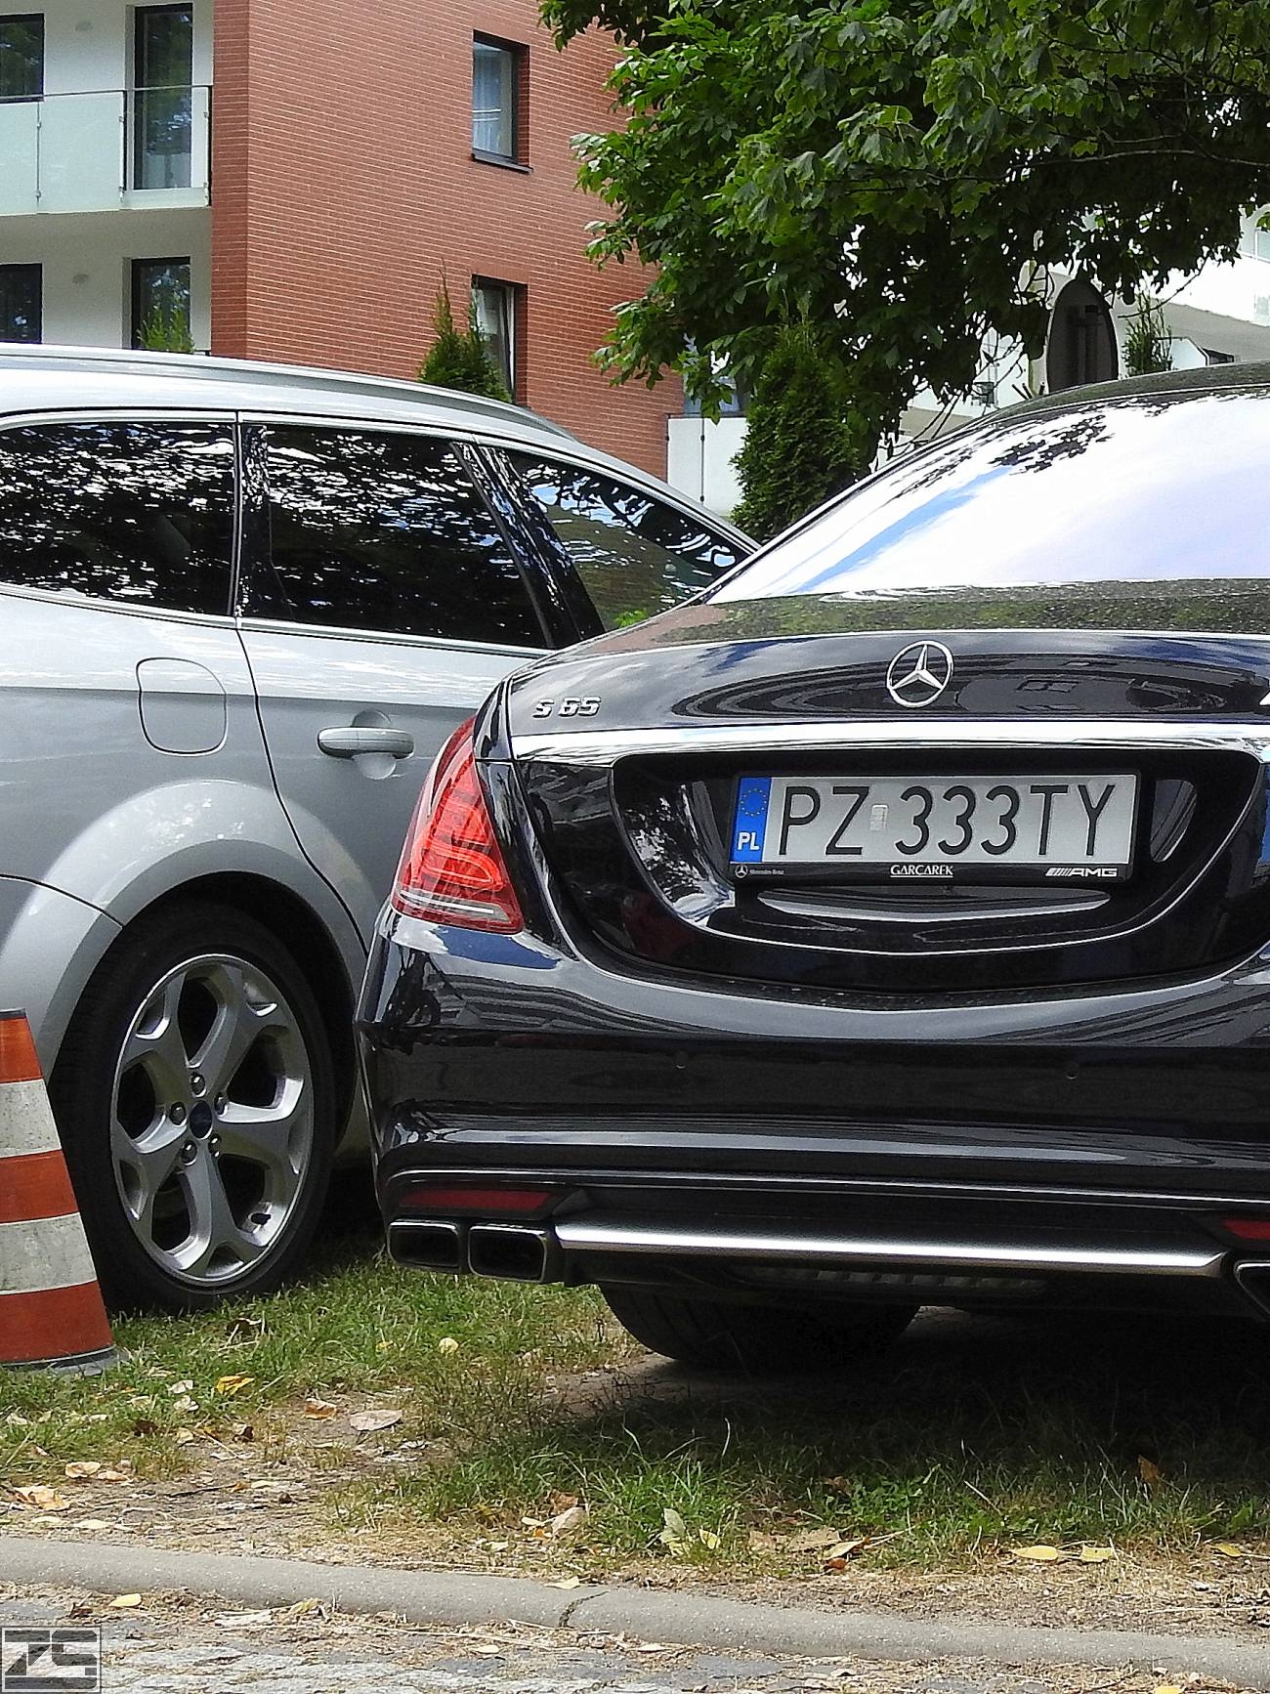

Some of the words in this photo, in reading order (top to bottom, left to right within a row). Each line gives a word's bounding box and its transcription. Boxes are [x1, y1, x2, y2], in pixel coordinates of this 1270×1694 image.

[532, 698, 554, 719] S
[558, 696, 601, 717] 65
[778, 786, 870, 856] PZ
[895, 785, 1116, 857] 333TY
[737, 831, 760, 851] PL
[1069, 867, 1118, 878] AMG
